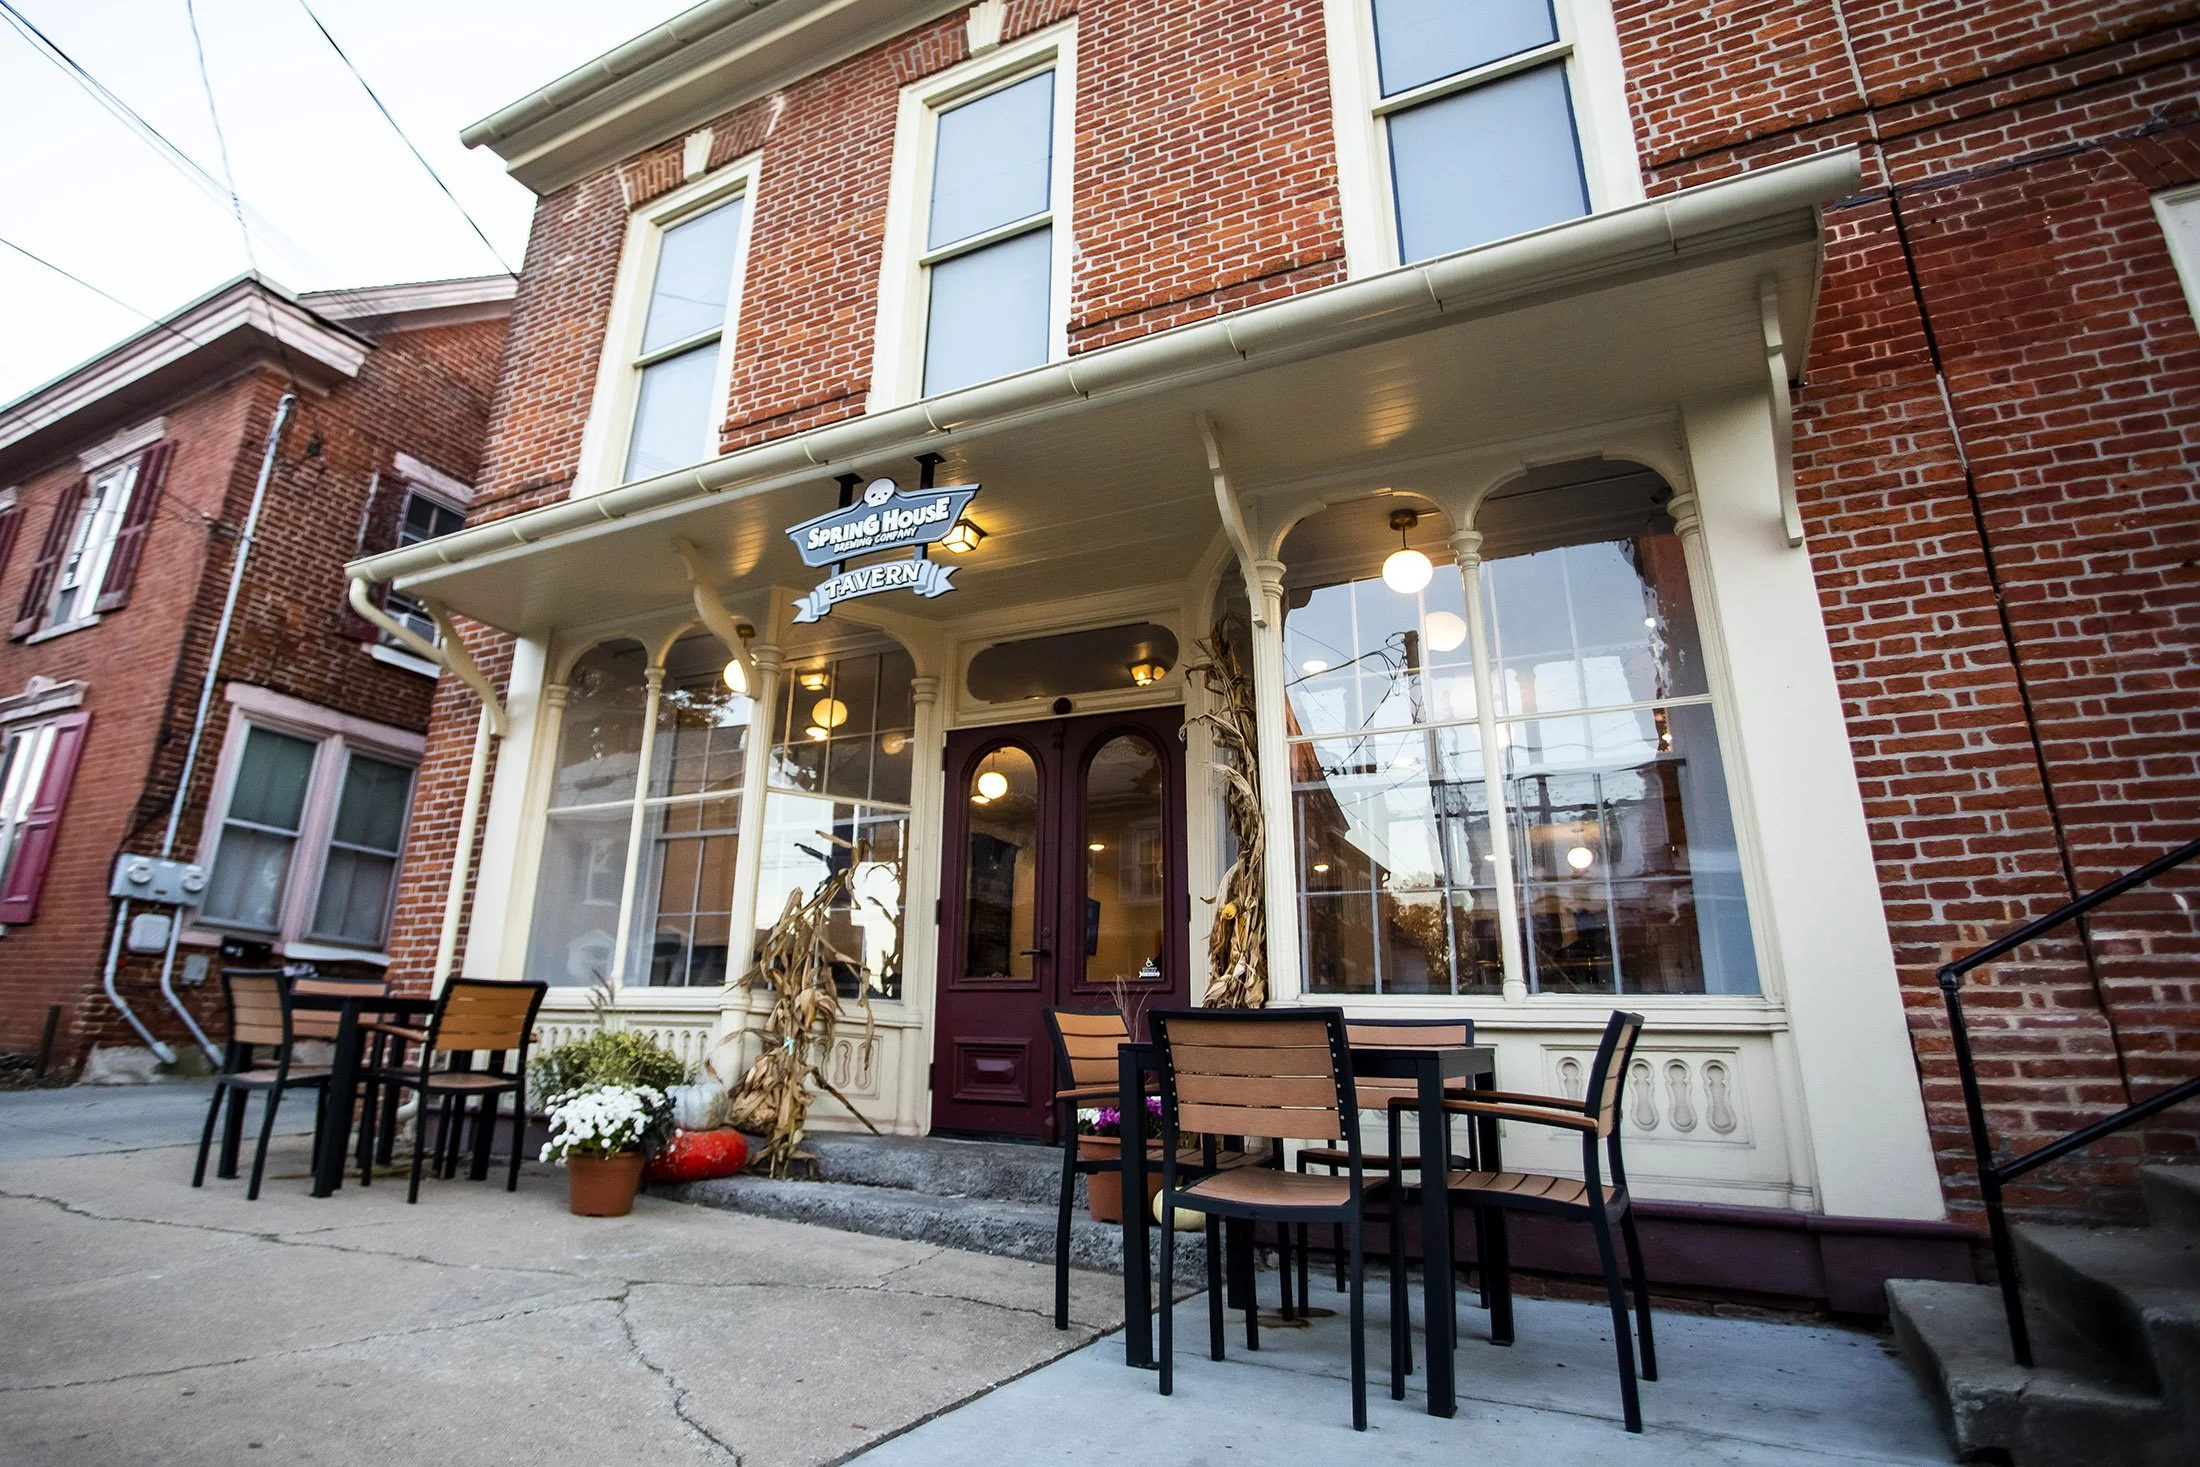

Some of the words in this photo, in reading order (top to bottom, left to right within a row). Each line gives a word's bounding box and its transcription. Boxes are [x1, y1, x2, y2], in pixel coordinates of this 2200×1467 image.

[807, 513, 880, 550] SPRING
[882, 496, 950, 532] HOUSE
[833, 537, 873, 553] BREWING
[875, 526, 918, 544] COMPANY
[825, 562, 922, 599] TAVERN
